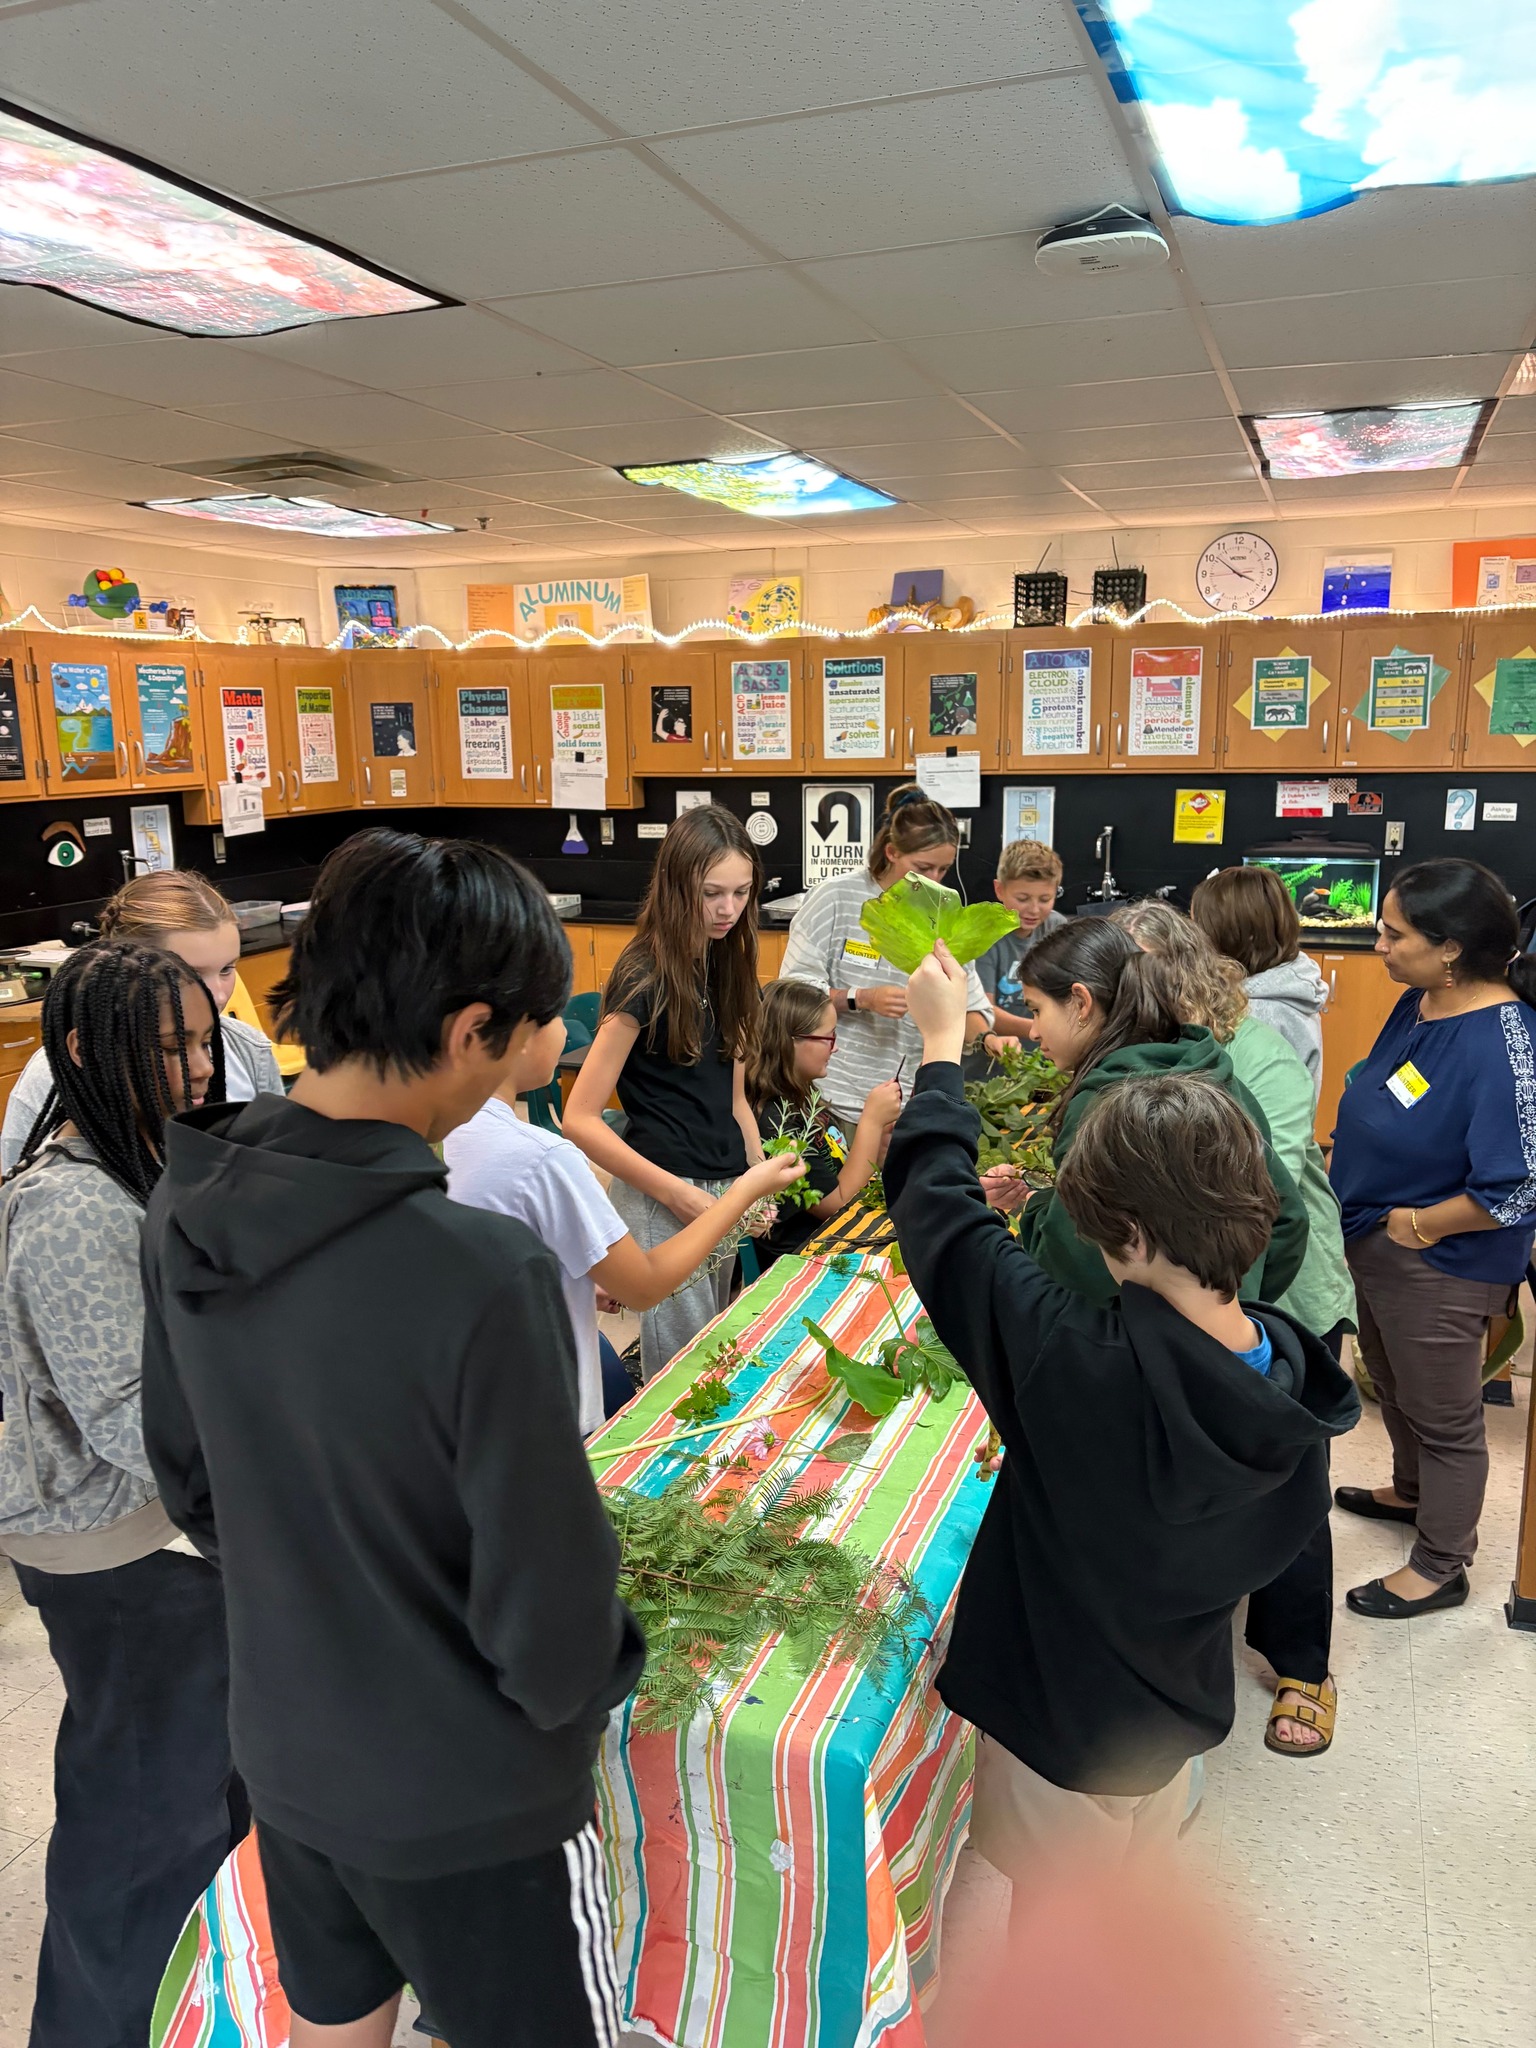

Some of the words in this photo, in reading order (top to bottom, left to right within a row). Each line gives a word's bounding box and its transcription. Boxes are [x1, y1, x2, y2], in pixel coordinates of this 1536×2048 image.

[1234, 536, 1245, 544] 12
[1216, 542, 1226, 550] 11
[1253, 541, 1257, 549] 1
[1205, 554, 1215, 562] 10
[1263, 552, 1271, 560] 2
[1201, 570, 1207, 578] 9
[1266, 568, 1273, 576] 3
[1204, 586, 1211, 594] 8
[518, 581, 621, 623] ALUMINUM
[1214, 598, 1221, 606] 7
[1248, 597, 1255, 605] 5
[1231, 602, 1238, 610] 6
[1027, 650, 1088, 668] ATOMS
[736, 664, 772, 677] ACIDS
[776, 663, 785, 676] &
[826, 661, 881, 675] Solutions
[1029, 671, 1069, 680] ELECTRON
[742, 678, 780, 691] BASES
[1029, 679, 1068, 688] CLOUD
[1077, 669, 1086, 705] atomic
[298, 690, 331, 701] Properties
[461, 690, 506, 702] Physical
[829, 687, 880, 696] unsaturated
[1029, 687, 1068, 696] electrons
[223, 689, 263, 706] Matter
[829, 697, 880, 705] supersaturated
[1042, 696, 1076, 704] NUCLEUS
[1185, 677, 1195, 718] elements
[309, 704, 330, 712] Matter
[737, 694, 745, 714] ACID
[762, 700, 786, 710] juice
[1028, 698, 1041, 719] ion
[461, 703, 507, 715] Changes
[829, 705, 880, 713] saturated
[1042, 705, 1076, 713] protons
[573, 711, 600, 722] light
[1144, 717, 1181, 725] periods
[470, 718, 497, 728] shape
[563, 712, 571, 738] change
[573, 722, 600, 730] sound
[1076, 707, 1085, 748] number
[1042, 726, 1075, 734] positive
[1153, 725, 1194, 733] Mendeleev
[849, 729, 879, 739] solvent
[465, 739, 500, 750] freezing
[557, 740, 577, 748] solid
[1043, 740, 1075, 749] neutral
[500, 725, 508, 773] condensation
[757, 746, 767, 754] pH
[229, 736, 237, 772] density
[248, 756, 266, 764] liquid
[811, 845, 820, 858] U
[824, 845, 863, 858] TURN
[820, 858, 864, 866] HOMEWORK
[820, 867, 828, 877] U
[845, 948, 877, 960] VOLUNTEER
